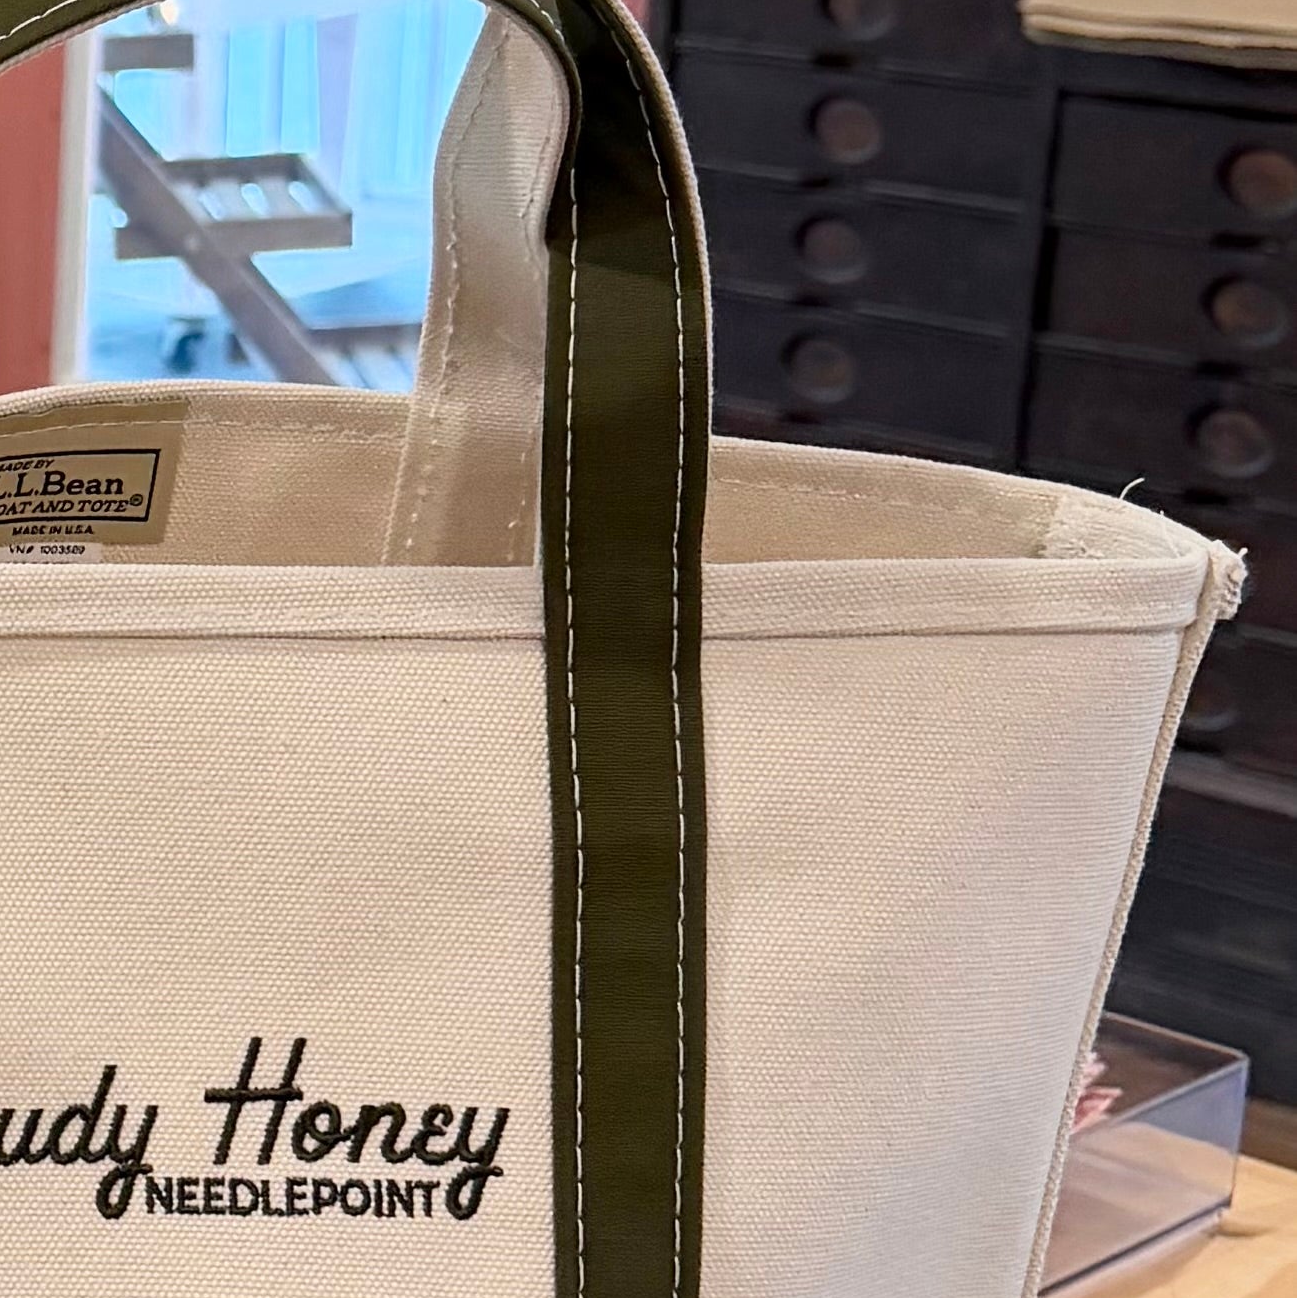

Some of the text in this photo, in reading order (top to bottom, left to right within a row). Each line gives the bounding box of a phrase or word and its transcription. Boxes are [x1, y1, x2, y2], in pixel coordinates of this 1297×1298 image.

[34, 459, 55, 469] BY
[32, 500, 74, 513] AND
[12, 525, 46, 536] MADE
[49, 525, 62, 535] IN
[203, 1036, 511, 1221] Honey
[145, 1176, 441, 1219] NEEDLEPOINT
